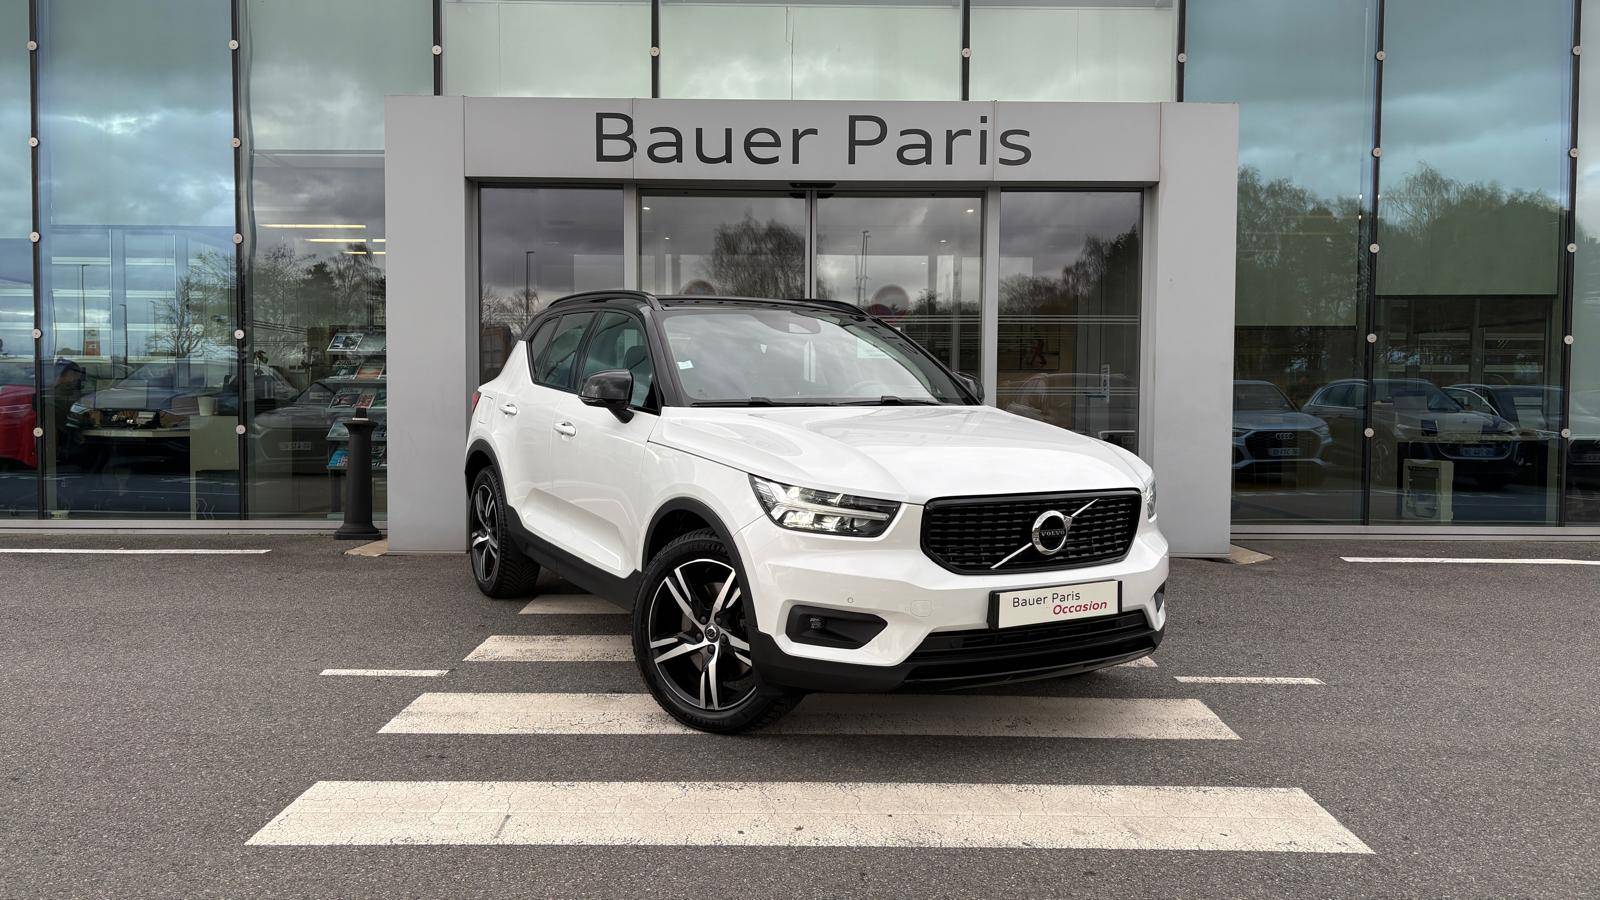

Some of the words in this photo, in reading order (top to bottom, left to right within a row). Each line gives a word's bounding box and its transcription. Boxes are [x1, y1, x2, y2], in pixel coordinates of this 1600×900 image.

[595, 112, 818, 164] Bauer
[847, 114, 1032, 166] Paris
[1012, 596, 1048, 608] Bauer
[1052, 591, 1081, 603] Paris
[1052, 601, 1108, 615] Occasion
